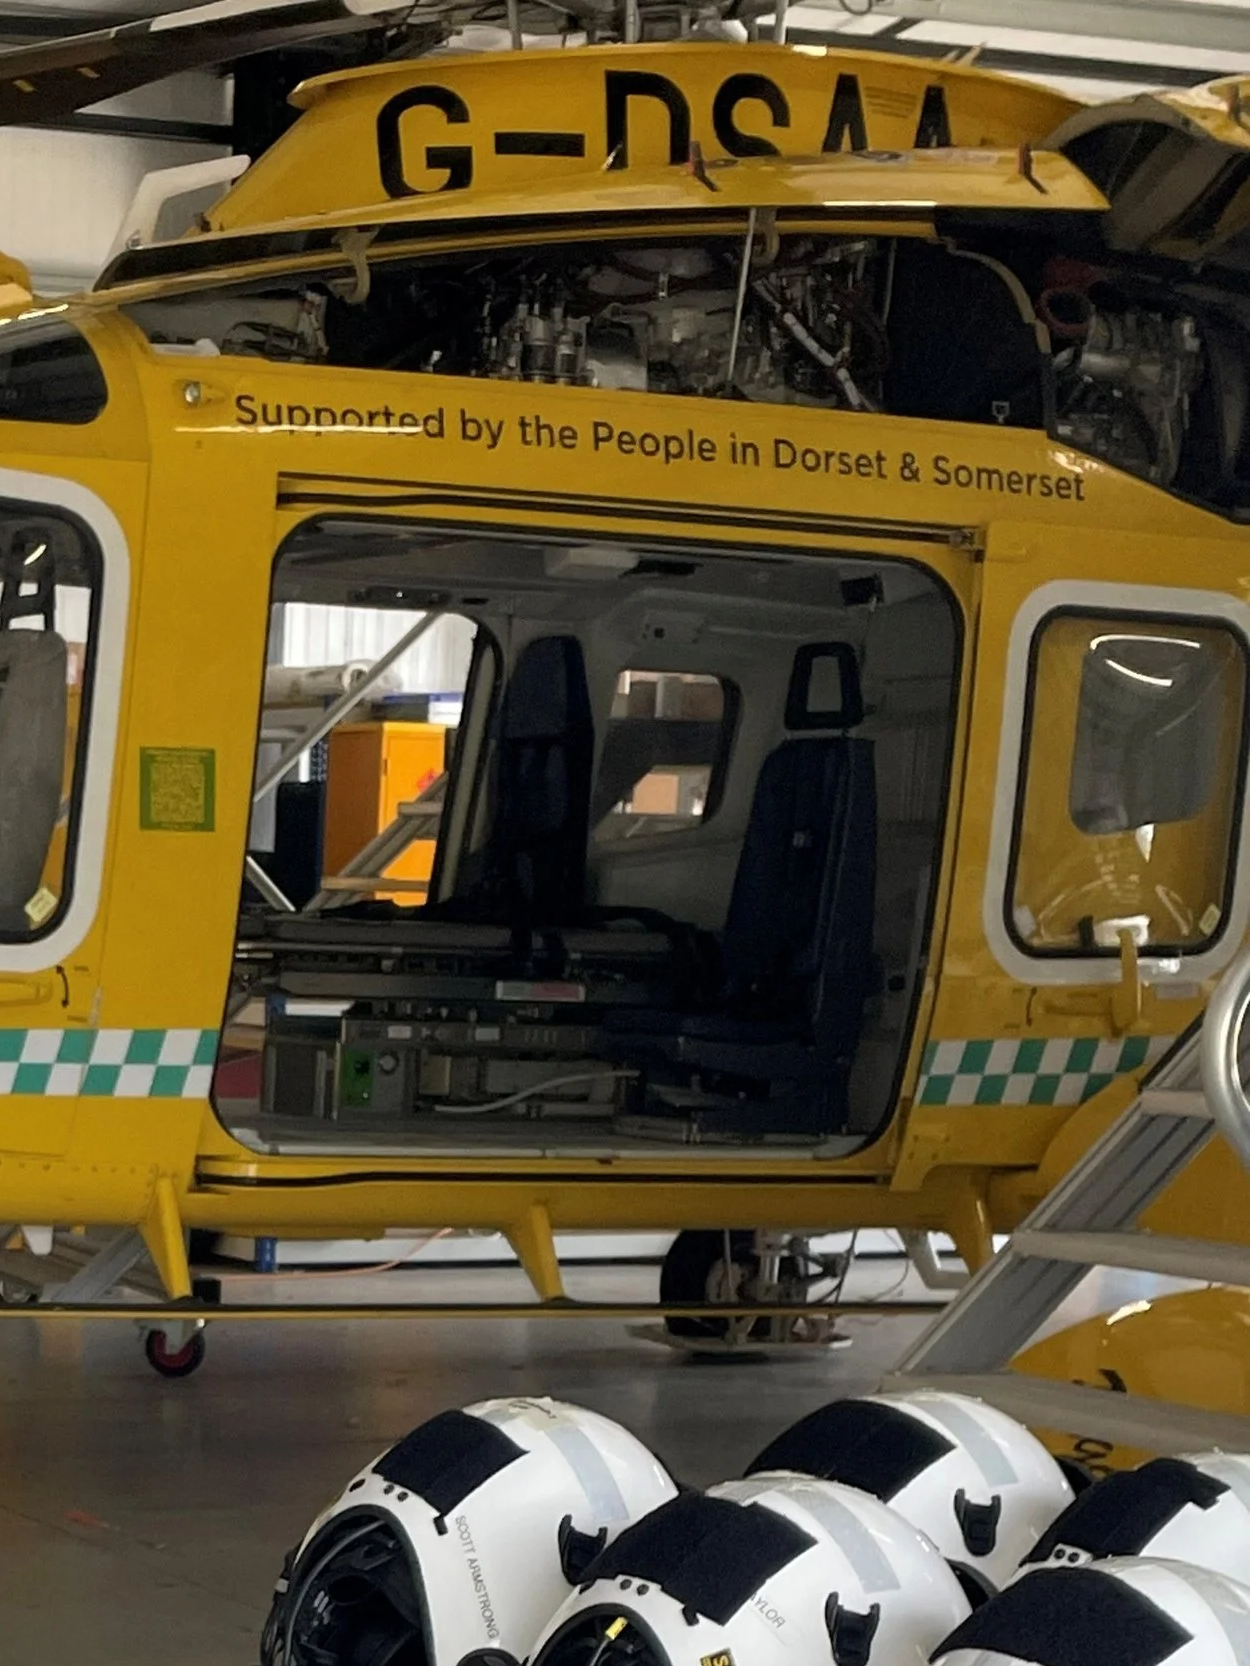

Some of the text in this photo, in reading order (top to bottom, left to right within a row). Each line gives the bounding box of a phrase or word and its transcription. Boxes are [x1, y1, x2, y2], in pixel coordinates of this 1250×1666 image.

[235, 394, 1086, 502] Supported by the People in Dorset & Somerset
[454, 1514, 500, 1640] SCOTT ARMSTRONG
